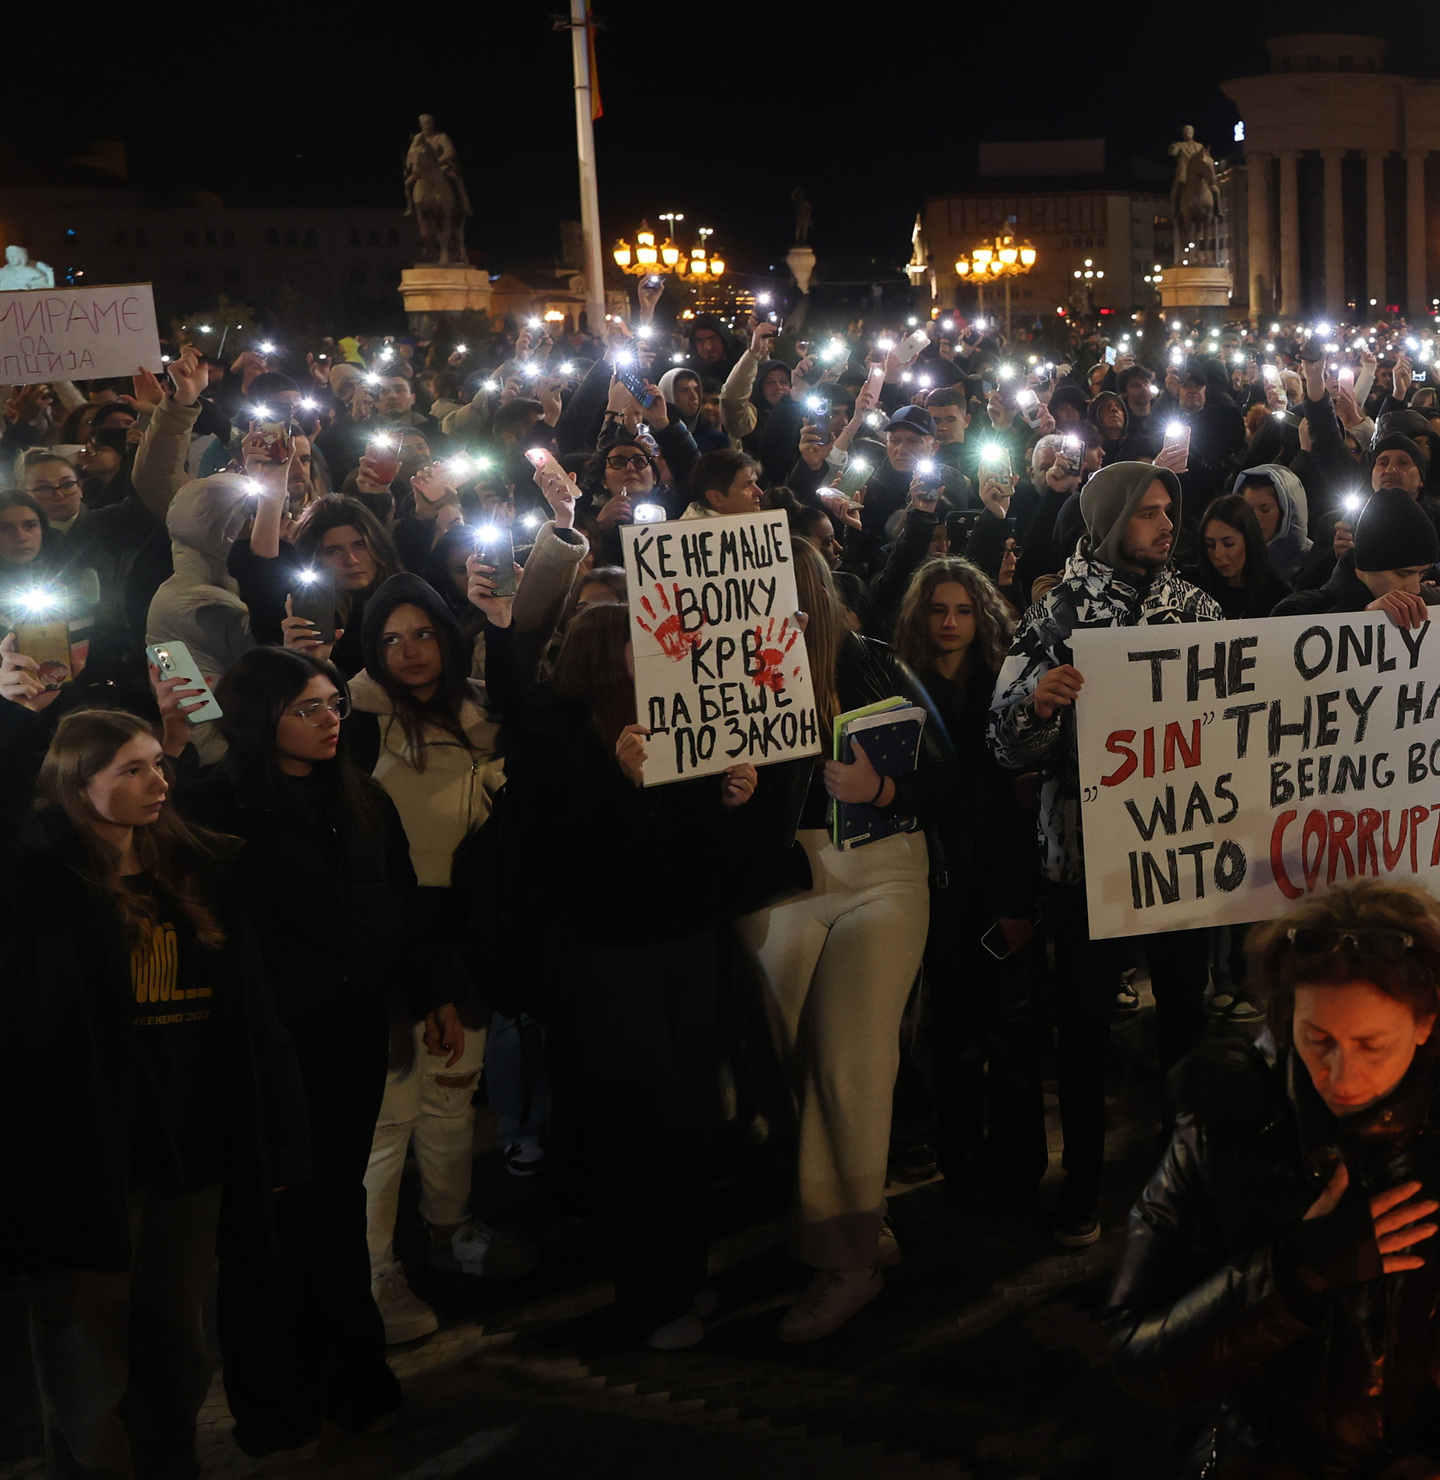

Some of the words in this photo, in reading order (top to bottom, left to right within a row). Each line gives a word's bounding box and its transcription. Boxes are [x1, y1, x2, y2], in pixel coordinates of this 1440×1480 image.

[0, 349, 96, 376] ПЦИЈА
[19, 335, 54, 357] ОД
[633, 527, 677, 587] ЌЕ
[680, 522, 789, 579] НЕМАШЕ
[690, 629, 766, 685] КРВ
[1127, 635, 1259, 703] THE
[1293, 620, 1432, 682] ONLY
[647, 692, 693, 741] ДА
[698, 672, 793, 724] БЕШЕ
[674, 726, 717, 774] ПО
[724, 707, 817, 759] ЗАКОН
[1222, 685, 1383, 760] THEY
[1123, 772, 1240, 842] WAS
[1269, 751, 1396, 809] BEING
[1128, 839, 1248, 910] INTO
